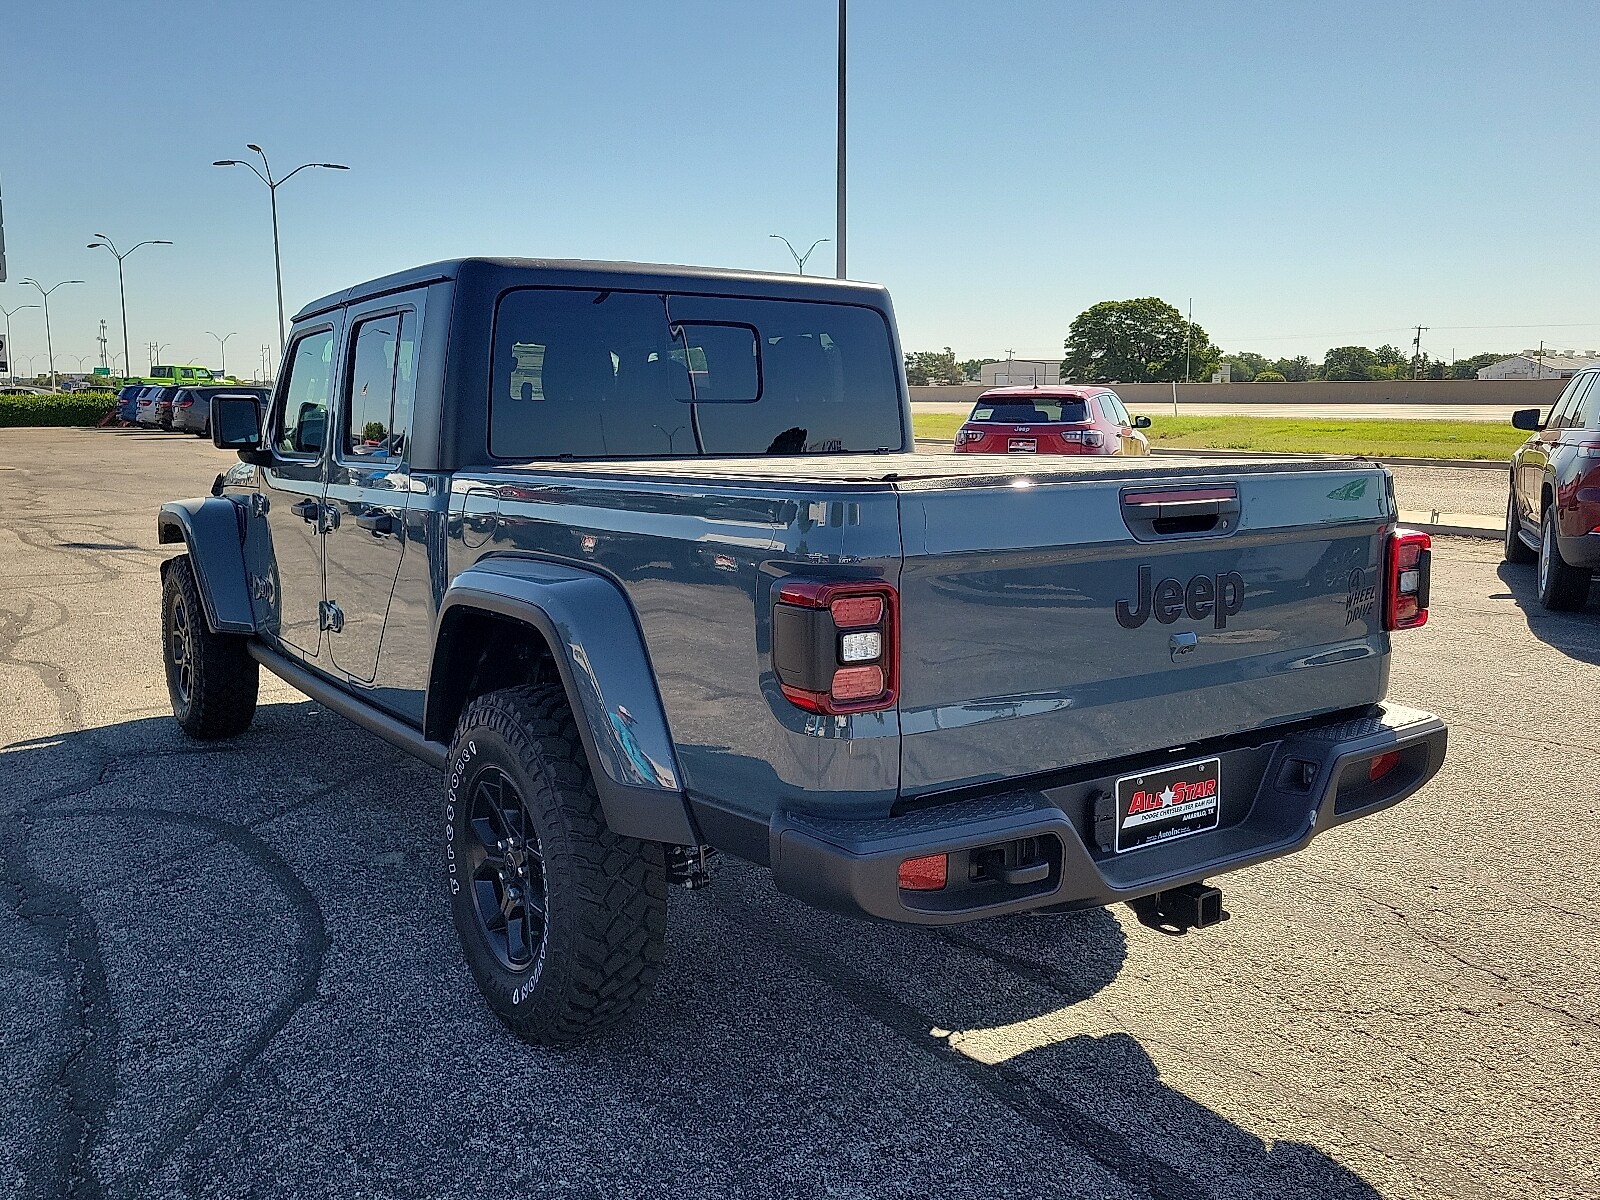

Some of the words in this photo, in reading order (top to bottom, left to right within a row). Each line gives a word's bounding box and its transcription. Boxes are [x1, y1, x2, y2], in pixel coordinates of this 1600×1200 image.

[1115, 563, 1245, 629] Jeep
[1345, 585, 1376, 610] WHEEL
[1344, 601, 1374, 626] DRIVE
[1141, 811, 1160, 821] DODGE
[1159, 805, 1183, 817] CHRYSLER
[1194, 800, 1206, 809] RAM
[1205, 797, 1216, 806] FIAT
